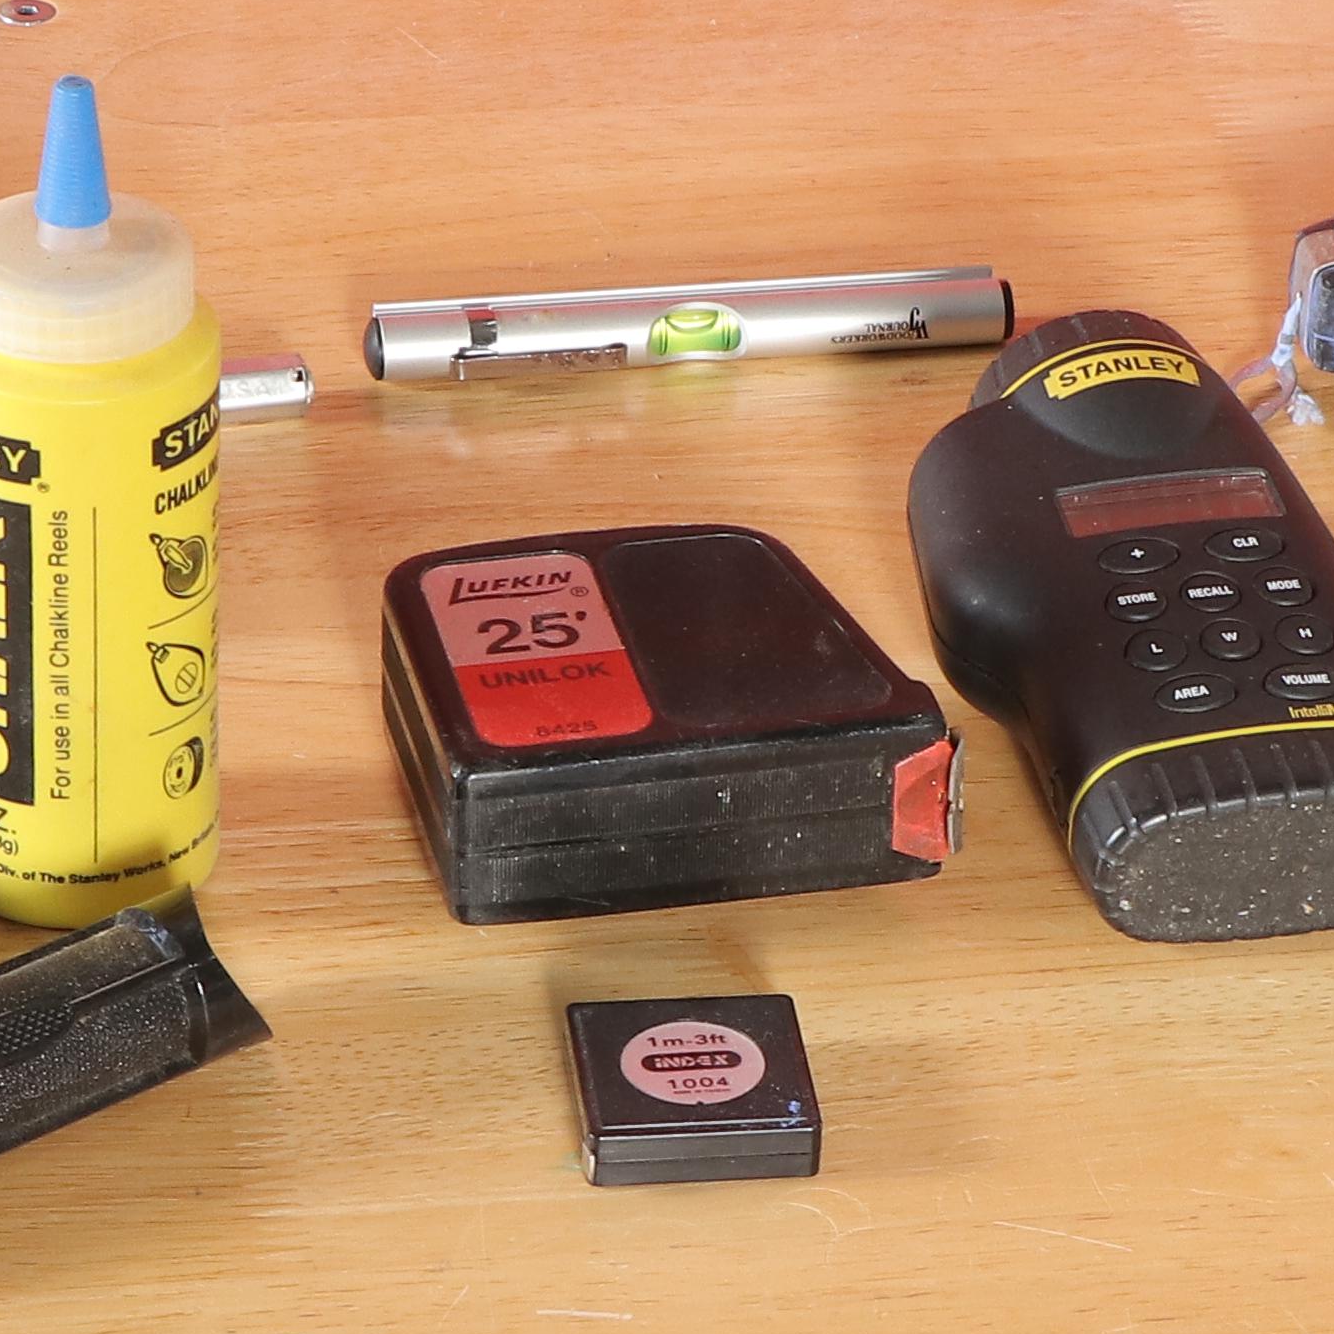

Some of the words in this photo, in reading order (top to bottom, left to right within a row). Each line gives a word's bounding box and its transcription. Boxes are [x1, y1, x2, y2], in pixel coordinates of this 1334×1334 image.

[1058, 356, 1184, 388] STANLEY
[48, 510, 68, 567] Reels
[1232, 536, 1259, 548] CLR
[449, 571, 572, 606] LUFKIN
[1117, 591, 1157, 606] STORE
[1188, 585, 1234, 599] RECALL
[1266, 579, 1301, 592] MODE
[48, 573, 69, 668] Chalkline
[1221, 631, 1238, 643] W
[1299, 627, 1313, 639] H
[1151, 643, 1163, 654] L
[479, 660, 612, 689] UNILOK
[1281, 673, 1331, 686] VOLUME
[50, 674, 69, 696] all
[1174, 685, 1210, 700] AREA
[50, 703, 69, 720] in
[55, 725, 71, 761] use
[50, 767, 71, 800] For
[22, 871, 37, 881] of
[38, 872, 66, 884] The
[68, 872, 120, 885] Stanley
[667, 1076, 729, 1090] 1004
